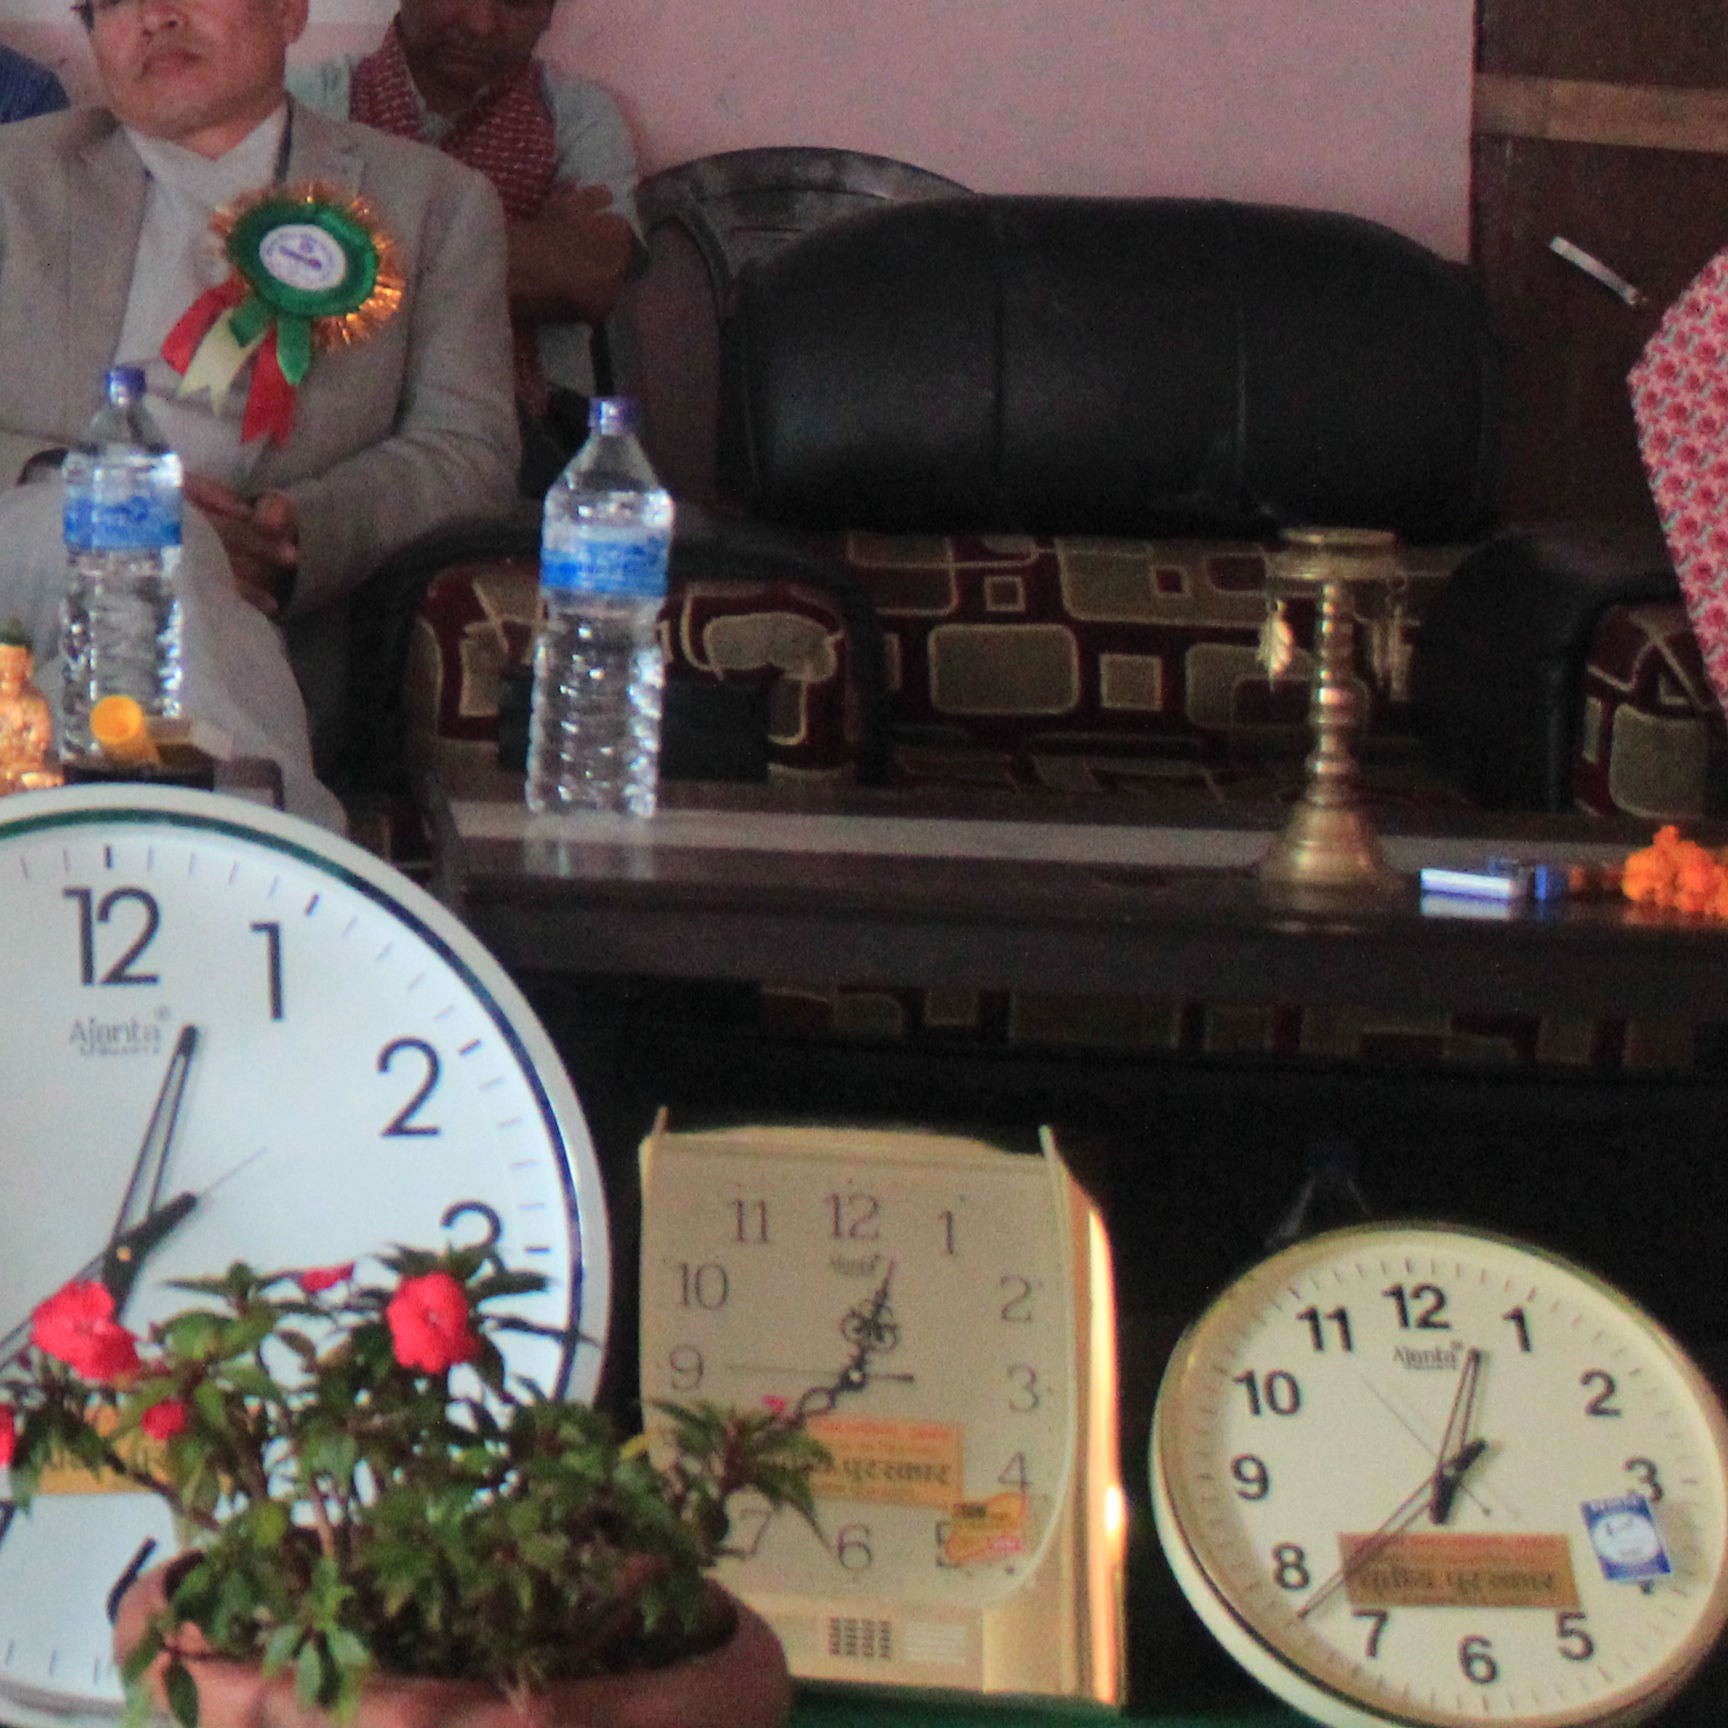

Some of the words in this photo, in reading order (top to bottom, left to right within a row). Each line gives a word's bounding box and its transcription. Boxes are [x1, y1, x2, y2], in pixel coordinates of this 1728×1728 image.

[63, 886, 161, 986] 12
[251, 921, 285, 1021] 1
[376, 1037, 442, 1139] 2
[730, 1199, 771, 1244] 11
[823, 1192, 881, 1241] 12
[939, 1210, 955, 1255] 1
[678, 1262, 730, 1310] 10
[1000, 1275, 1033, 1324] 2
[1382, 1284, 1452, 1330] 12
[1296, 1306, 1354, 1352] 11
[1502, 1306, 1532, 1352] 1
[669, 1346, 704, 1391] 9
[1008, 1365, 1038, 1413] 3
[1234, 1370, 1302, 1416] 10
[1579, 1369, 1622, 1417] 2
[998, 1452, 1032, 1497] 4
[1230, 1454, 1270, 1501] 9
[838, 1524, 872, 1571] 6
[1271, 1544, 1310, 1590] 8
[1353, 1610, 1388, 1658] 7
[1557, 1613, 1594, 1660] 5
[1458, 1636, 1498, 1683] 6
